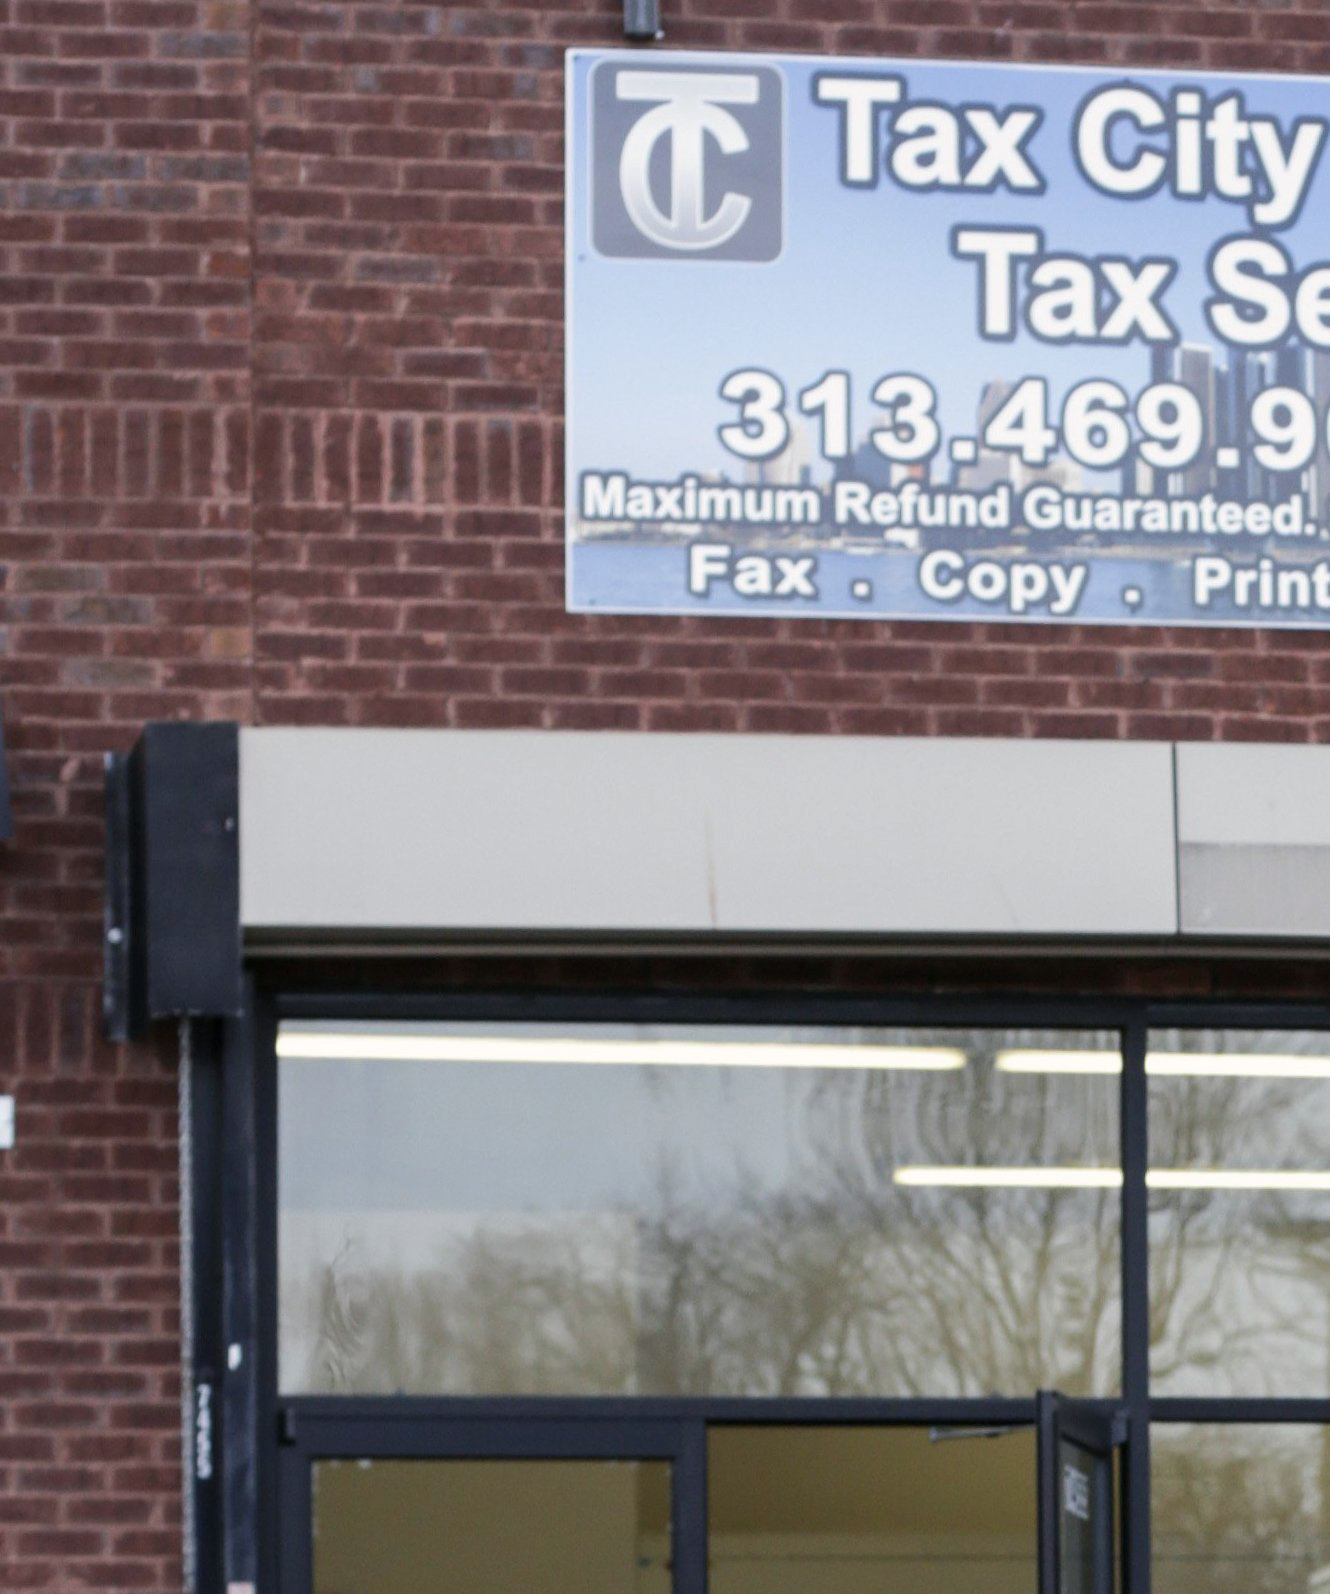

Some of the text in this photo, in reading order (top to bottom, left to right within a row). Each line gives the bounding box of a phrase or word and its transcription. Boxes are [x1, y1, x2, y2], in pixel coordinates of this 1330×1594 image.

[815, 75, 1327, 227] Tax City
[953, 228, 1176, 342] Tax
[581, 474, 821, 524] Maximum
[833, 479, 1010, 529] Refund
[1021, 486, 1317, 538] Guaranteed.
[688, 543, 818, 599] Fax
[918, 548, 1087, 615] Copy
